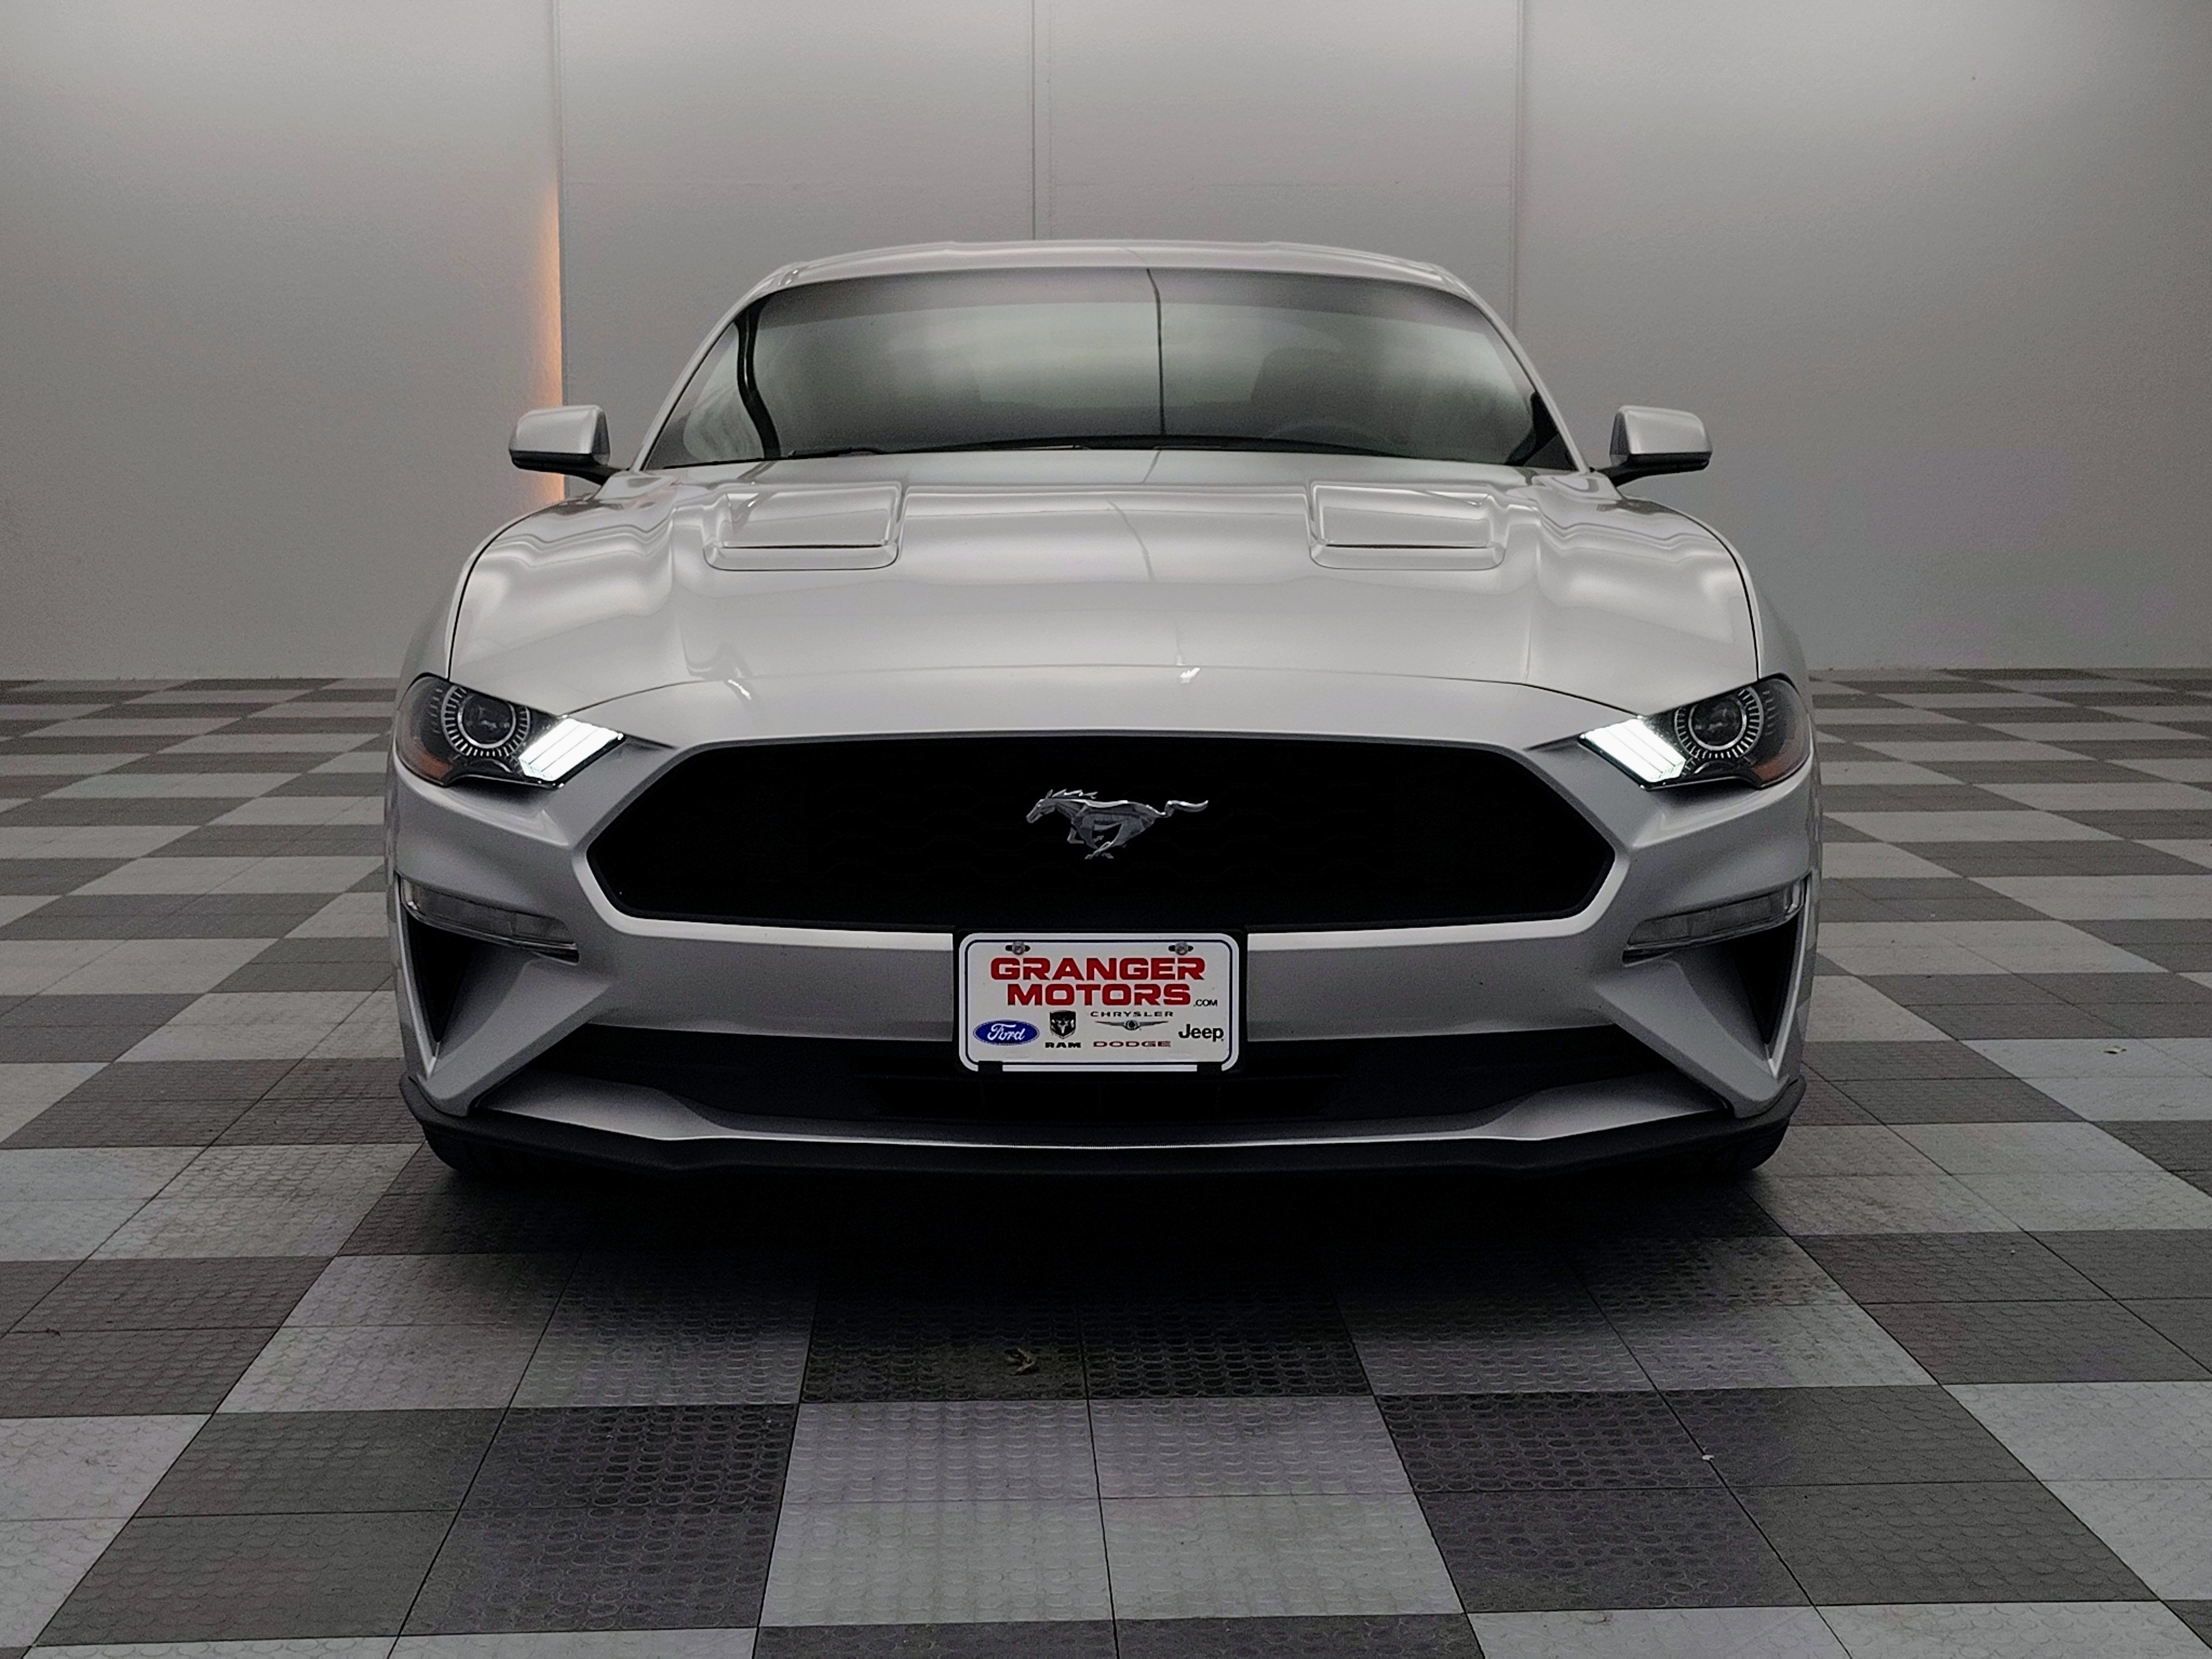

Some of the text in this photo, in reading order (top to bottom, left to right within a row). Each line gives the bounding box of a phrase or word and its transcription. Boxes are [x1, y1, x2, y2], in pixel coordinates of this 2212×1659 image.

[991, 958, 1205, 980] GRANGER
[1008, 984, 1190, 1006] MOTORS
[987, 1023, 1026, 1041] Ford
[1178, 1024, 1223, 1042] Jeep
